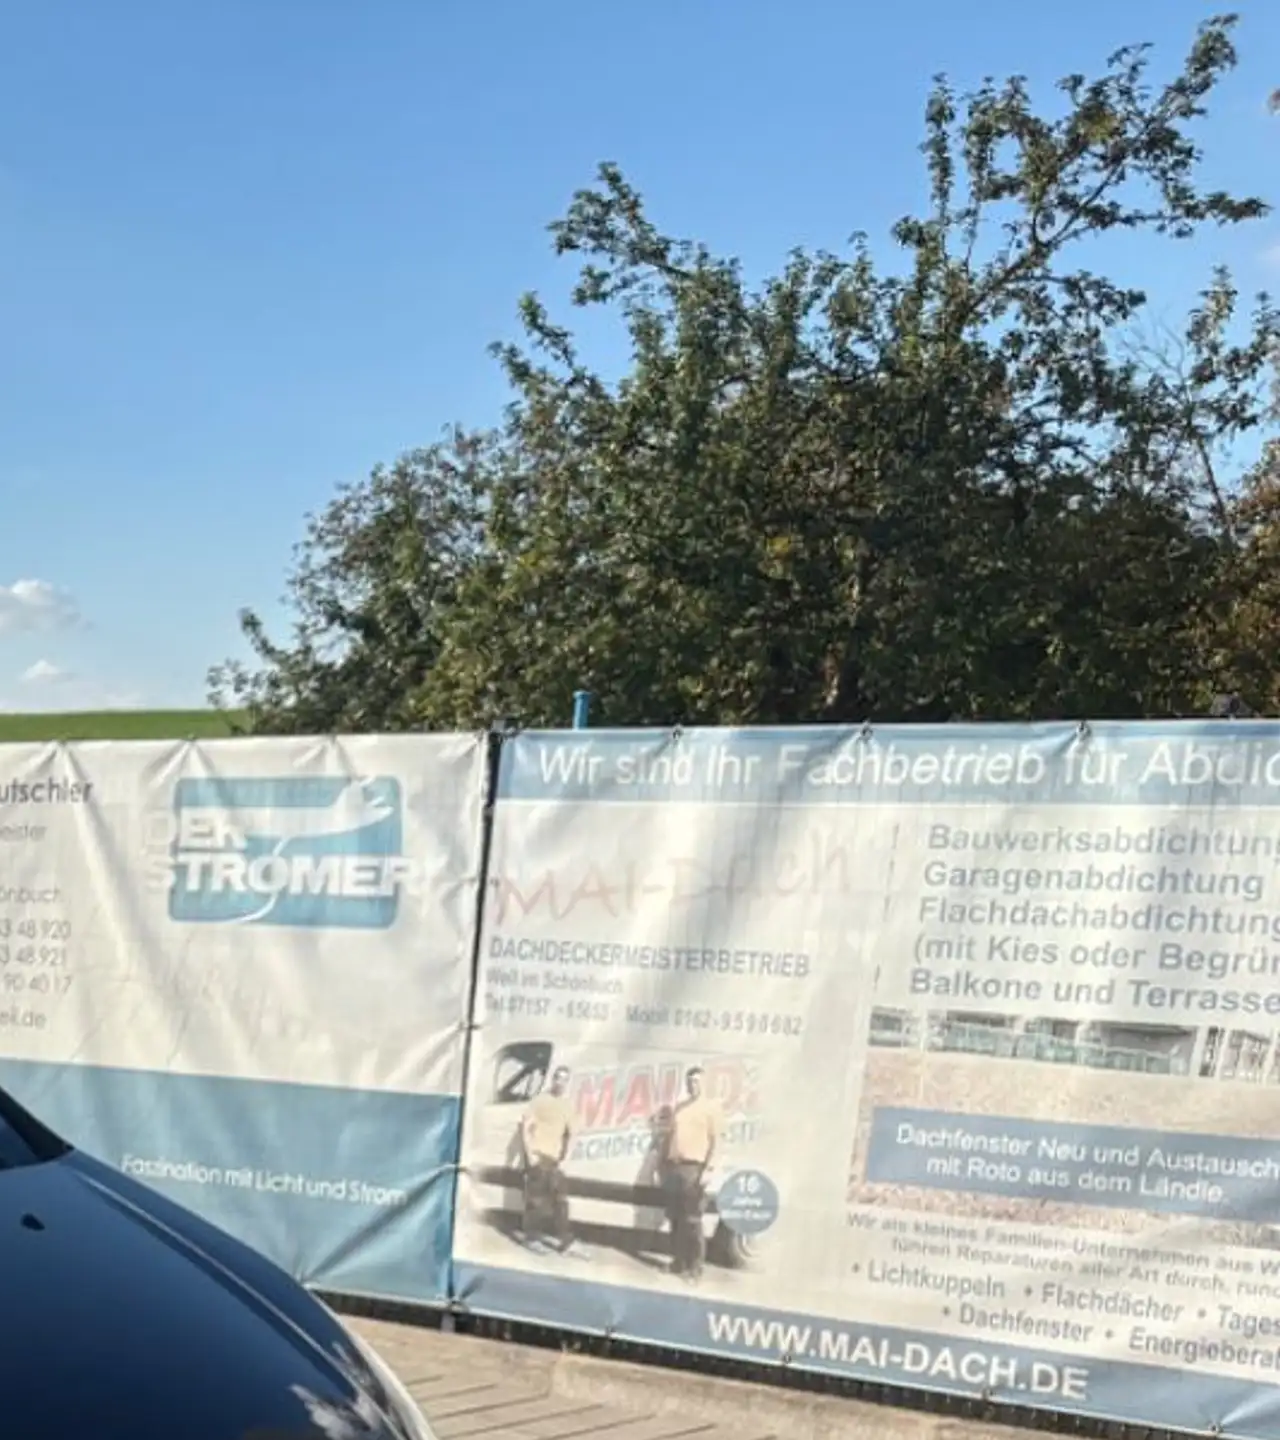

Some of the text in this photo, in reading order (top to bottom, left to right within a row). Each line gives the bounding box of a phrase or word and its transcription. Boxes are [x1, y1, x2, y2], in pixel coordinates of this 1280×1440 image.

[539, 744, 605, 784] Wir
[615, 742, 692, 785] sind
[706, 746, 760, 786] Ihr
[776, 742, 1045, 786] Fachbetrieb
[1062, 741, 1128, 785] für
[923, 860, 1265, 901] Garagenabdichtung
[914, 934, 977, 965] (mit
[987, 936, 1060, 965] Kies
[1069, 941, 1147, 970] oder
[909, 967, 1042, 1001] Balkone
[1052, 978, 1116, 1005] und
[895, 1122, 1033, 1158] Dachfenster
[1036, 1137, 1087, 1163] Neu
[1092, 1144, 1141, 1168] und
[120, 1153, 408, 1207] Faszination mit Licht und Strom
[925, 1154, 961, 1178] mit
[966, 1157, 1023, 1184] Roto
[1027, 1167, 1071, 1189] aus
[1077, 1169, 1133, 1194] dem
[867, 1259, 1007, 1302] Lichtkuppeln
[1040, 1282, 1185, 1323] Flachdächer
[957, 1301, 1095, 1344] Dachfenster
[706, 1311, 1091, 1400] WWW.MAI-DACH.DE
